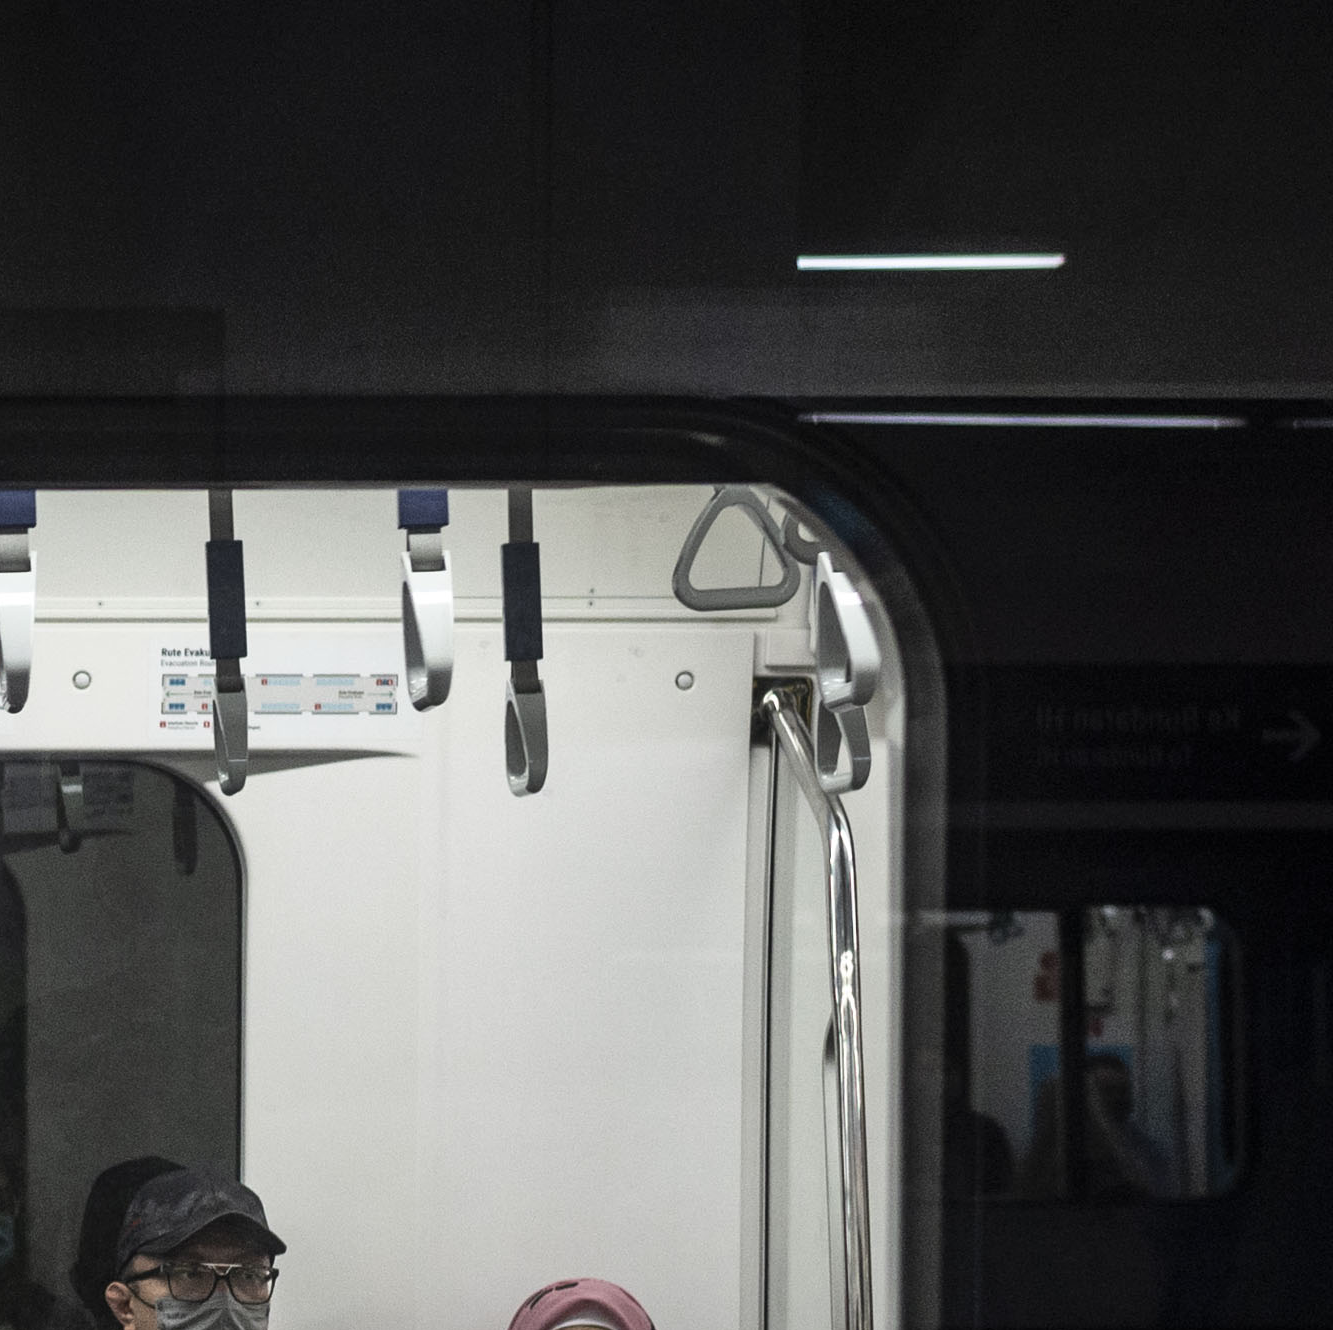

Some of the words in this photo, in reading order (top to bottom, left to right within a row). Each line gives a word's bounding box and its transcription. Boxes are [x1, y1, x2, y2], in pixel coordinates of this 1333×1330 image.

[161, 648, 181, 656] Rute
[184, 648, 211, 656] Evaku
[161, 659, 197, 667] Evacuation
